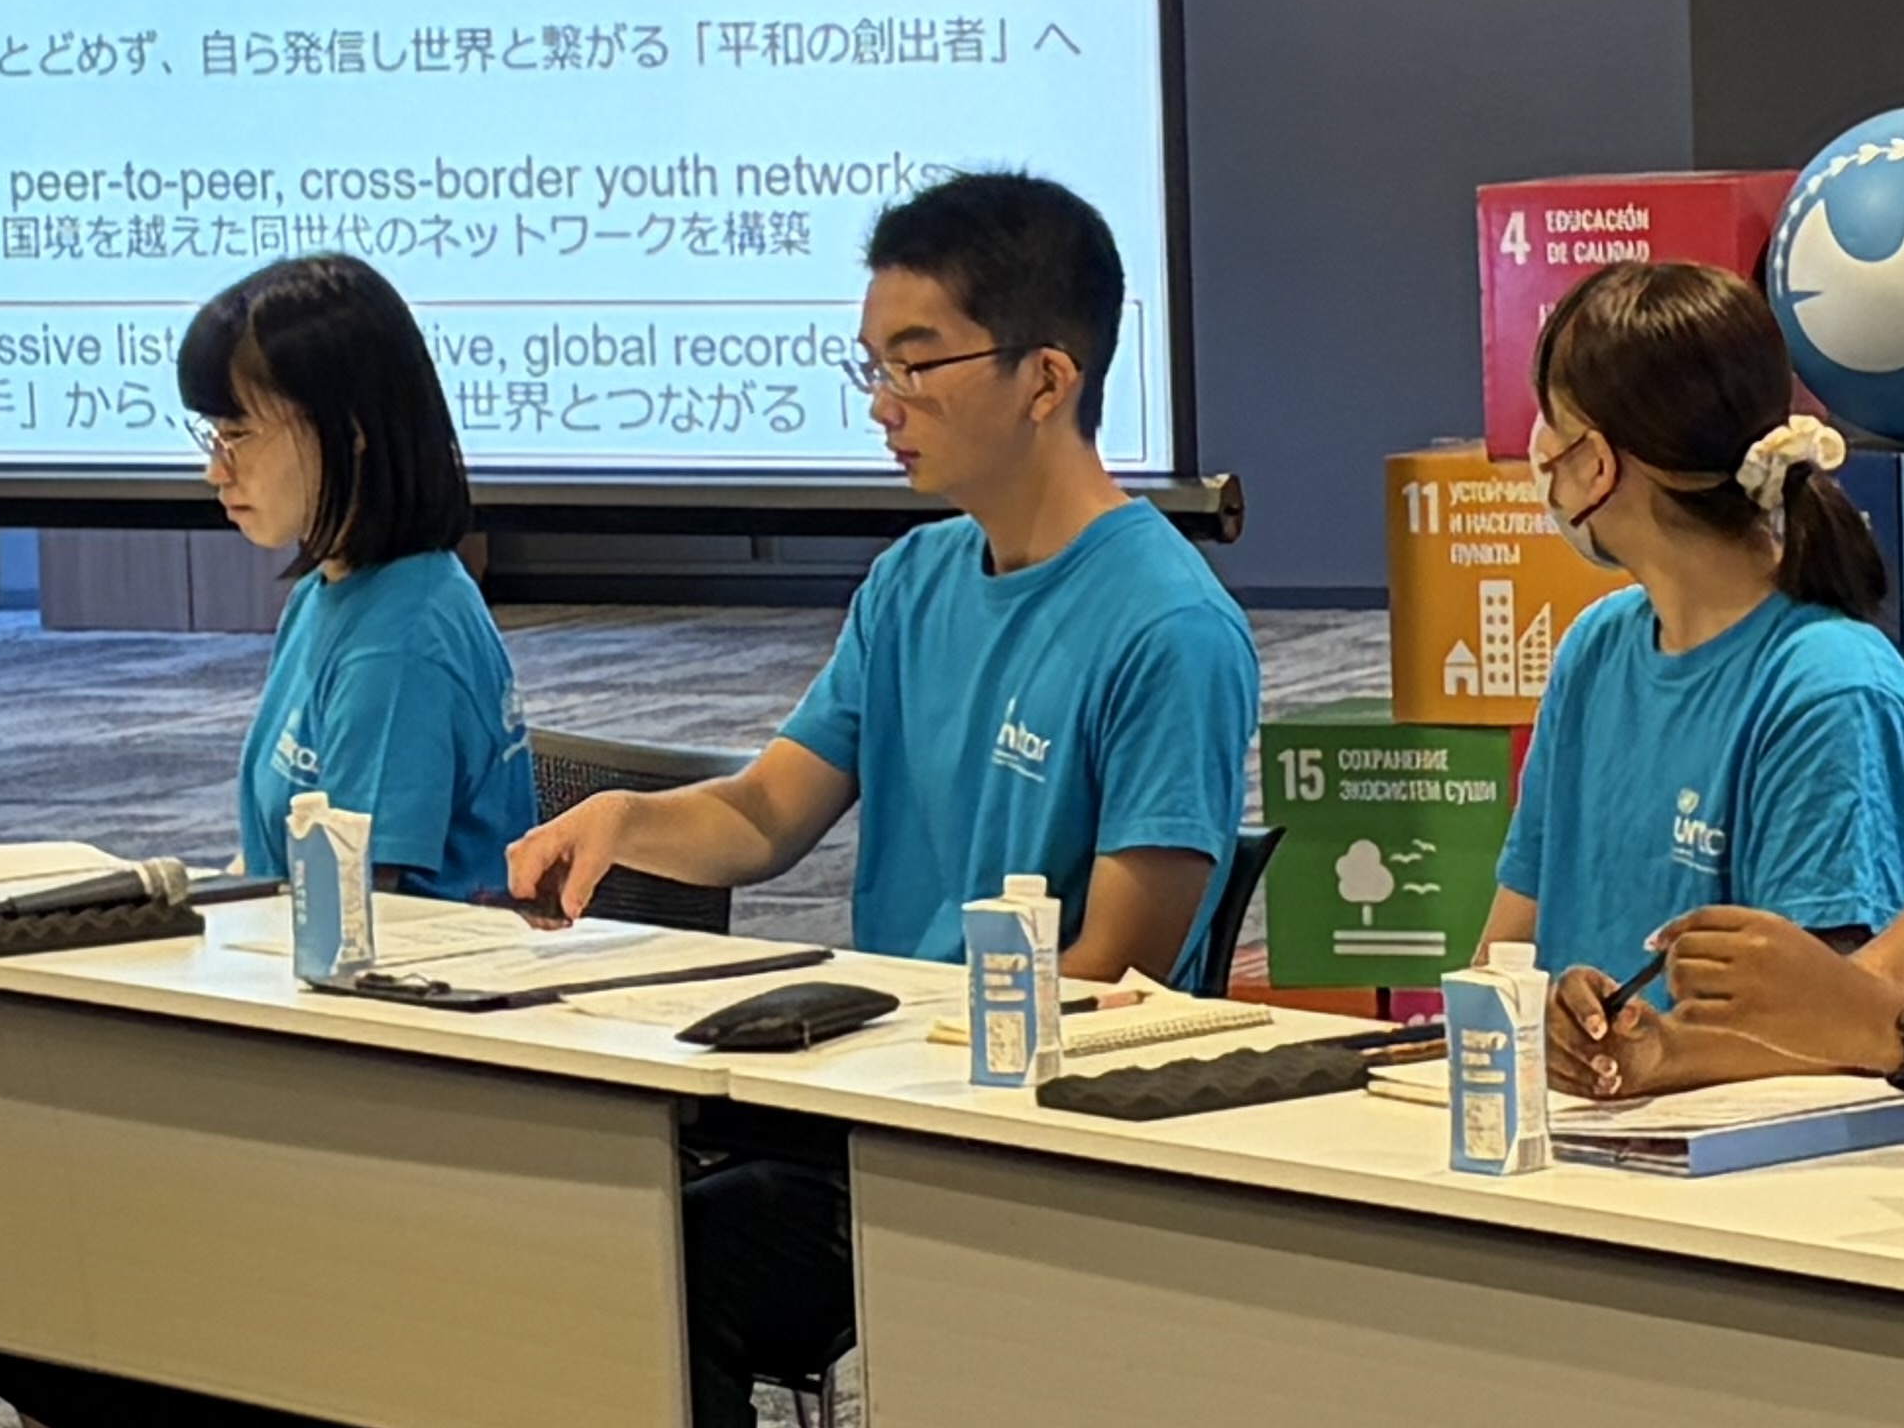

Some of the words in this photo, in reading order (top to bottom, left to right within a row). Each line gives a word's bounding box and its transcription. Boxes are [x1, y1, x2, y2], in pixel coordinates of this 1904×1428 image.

[10, 161, 283, 212] peer-to-peer,
[300, 154, 581, 200] cross-border
[595, 153, 717, 209] youth
[1500, 211, 1531, 265] 4
[1547, 242, 1569, 264] DE
[524, 322, 656, 377] global
[1401, 481, 1439, 534] 11
[1277, 749, 1325, 801] 15
